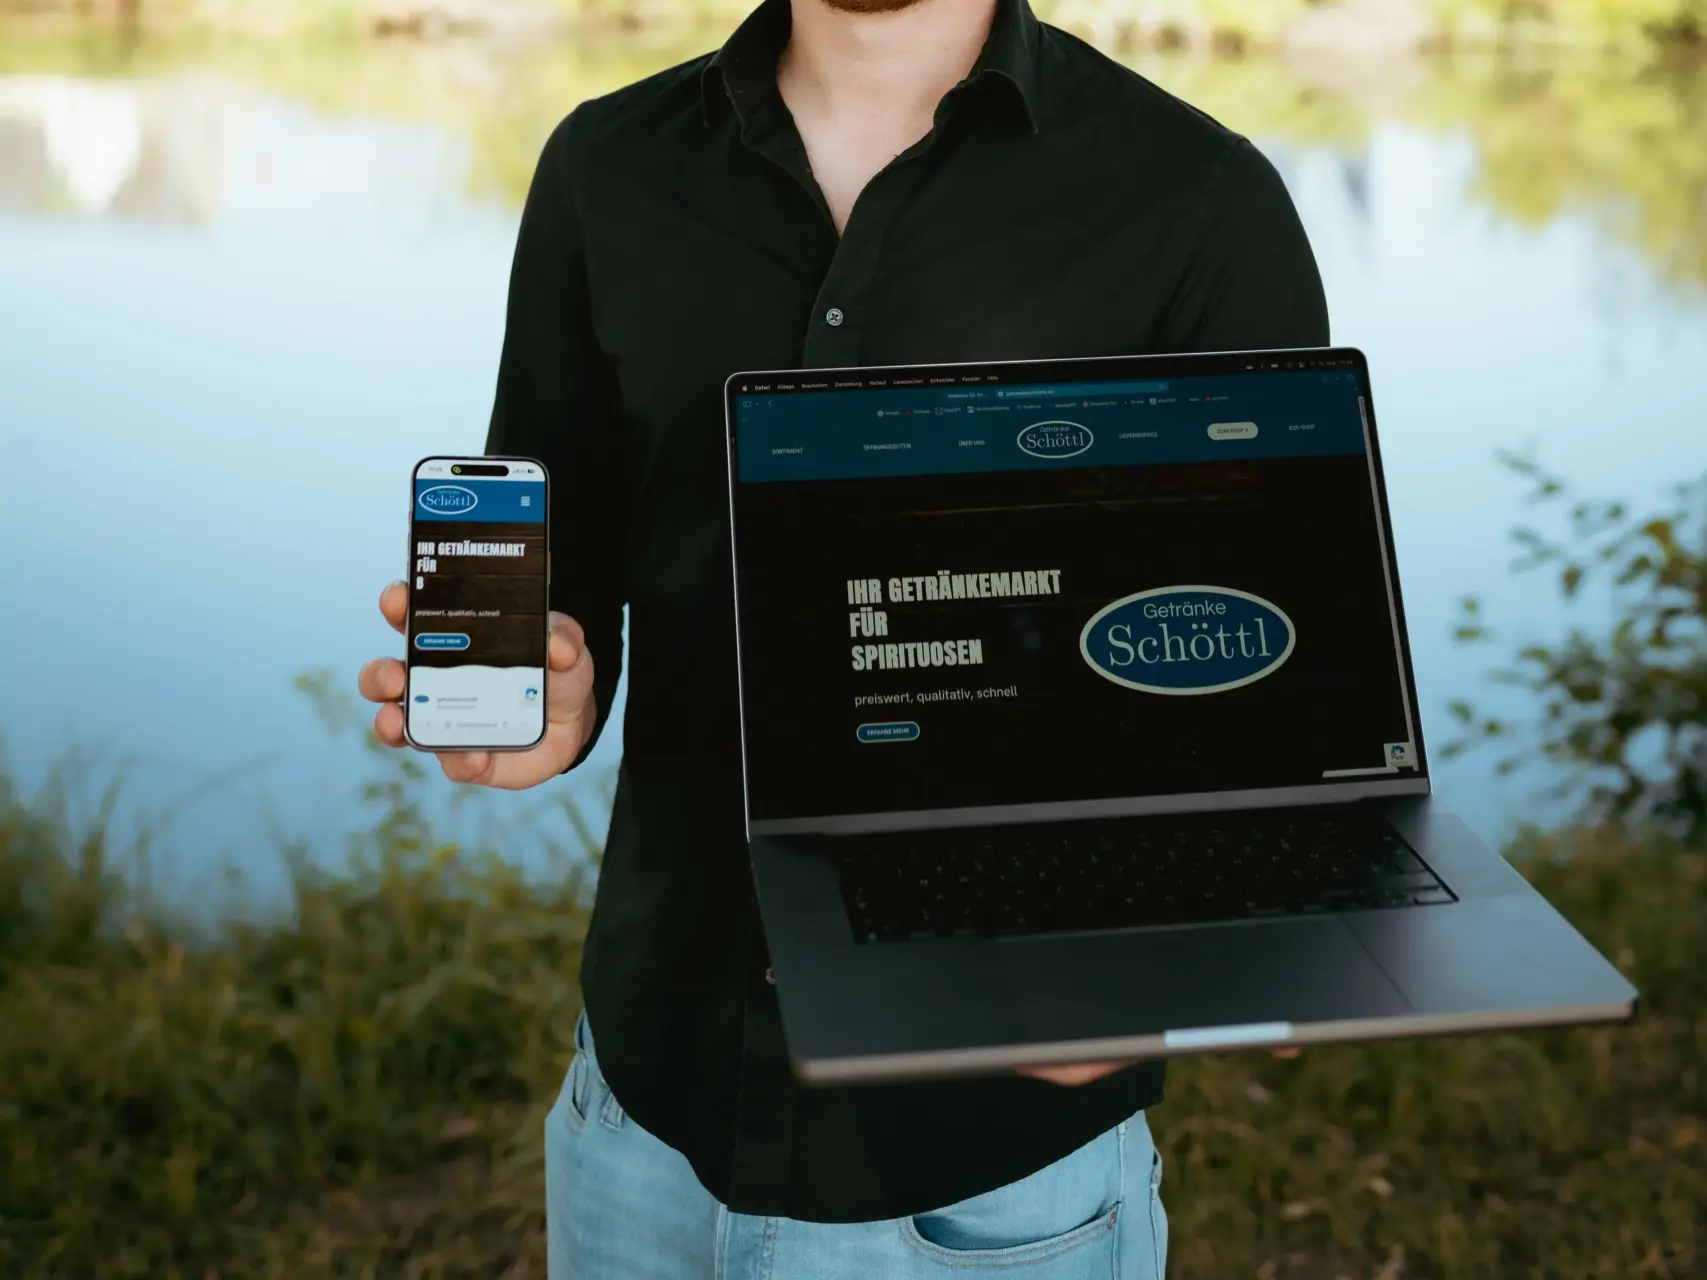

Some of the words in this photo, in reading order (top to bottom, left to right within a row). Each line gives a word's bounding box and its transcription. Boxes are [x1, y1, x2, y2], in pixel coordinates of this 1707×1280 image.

[834, 380, 863, 389] Darstellung
[1039, 425, 1070, 433] Getränke
[1026, 432, 1085, 449] Schöttl
[771, 447, 804, 455] SORTIMENT
[426, 494, 471, 507] Schöttl
[417, 541, 436, 556] IHR
[438, 540, 526, 557] GETRÄNKEMARKT
[416, 556, 438, 573] FÜR
[847, 578, 882, 605] IHR
[888, 569, 1061, 603] GETRÄNKEMARKT
[478, 610, 501, 618] schnell
[1143, 599, 1227, 619] Getränke
[849, 607, 888, 638] FÜR
[1107, 617, 1272, 667] Schöttl
[851, 638, 984, 671] SPIRITUOSEN
[854, 692, 914, 707] preiswert,
[916, 687, 974, 704] qualitativ,
[976, 685, 1018, 699] schnell
[866, 729, 893, 737] ERFAHRE
